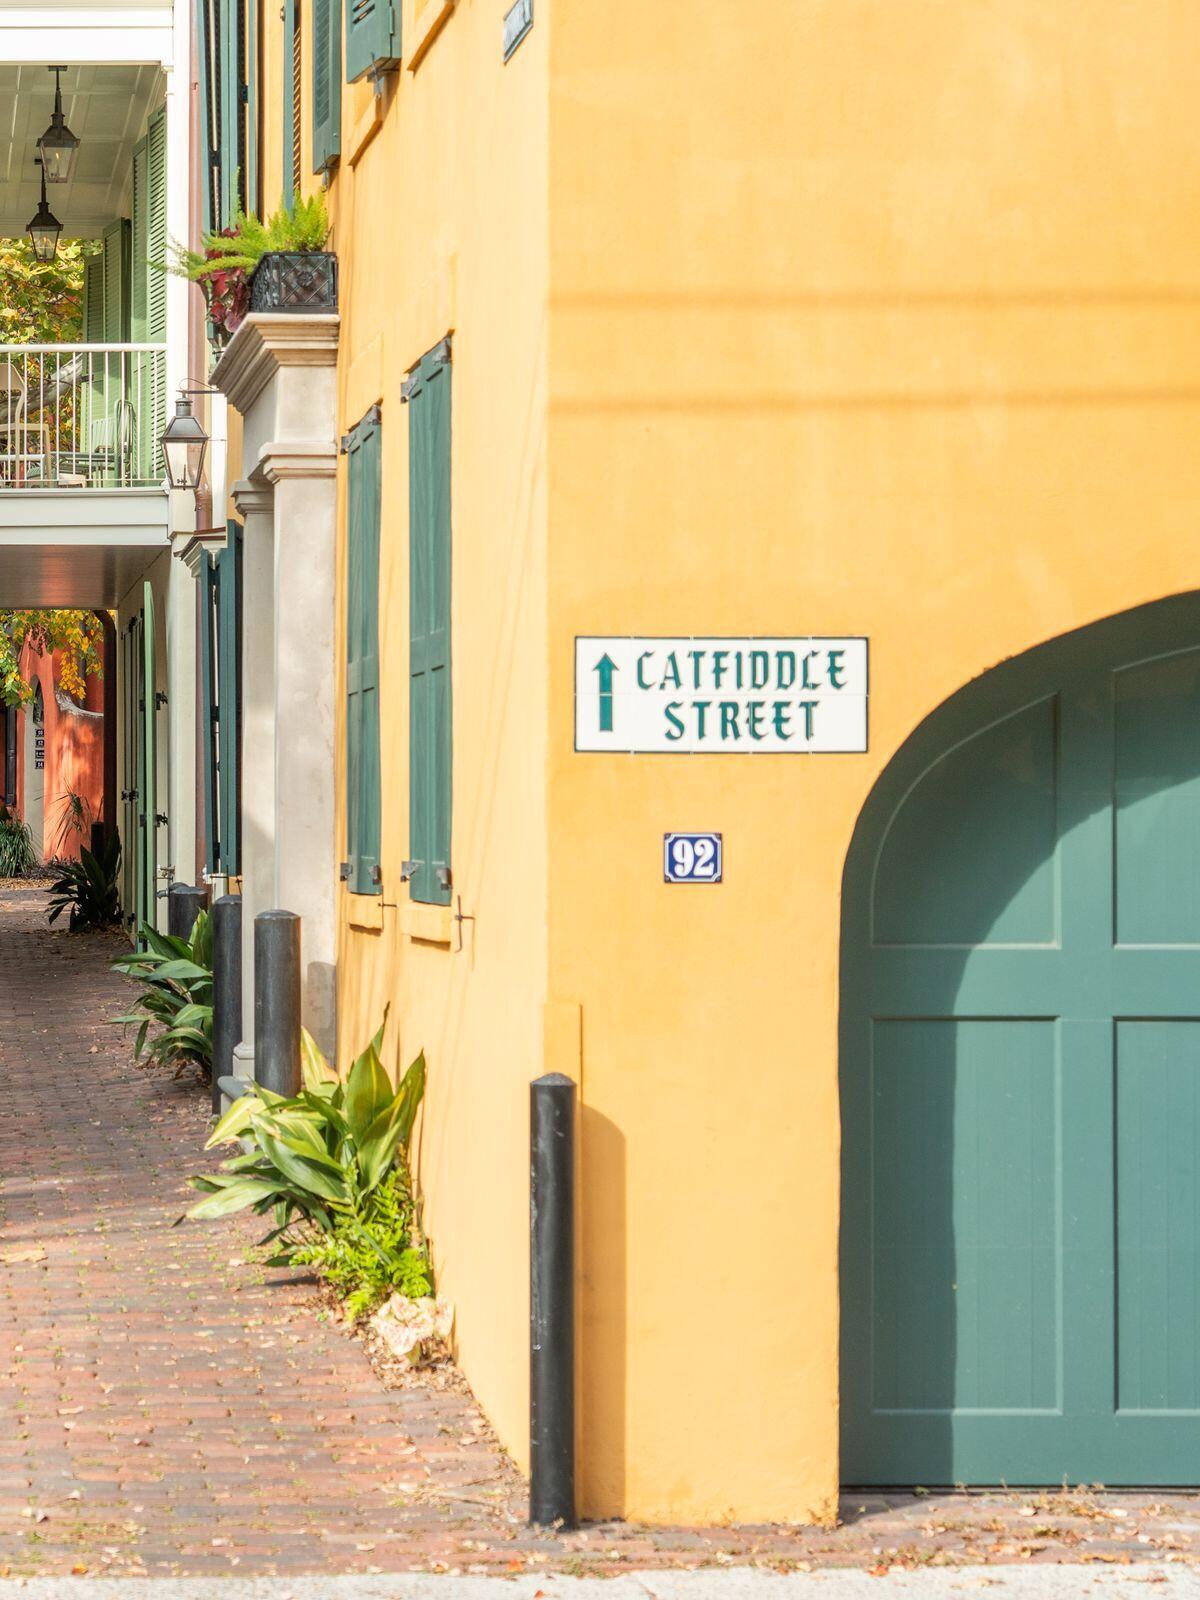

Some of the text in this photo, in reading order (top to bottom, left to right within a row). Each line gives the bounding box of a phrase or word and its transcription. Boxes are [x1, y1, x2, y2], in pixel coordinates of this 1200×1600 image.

[636, 650, 848, 691] CATFIDDLE
[663, 700, 820, 742] STREET
[672, 838, 715, 878] 92
